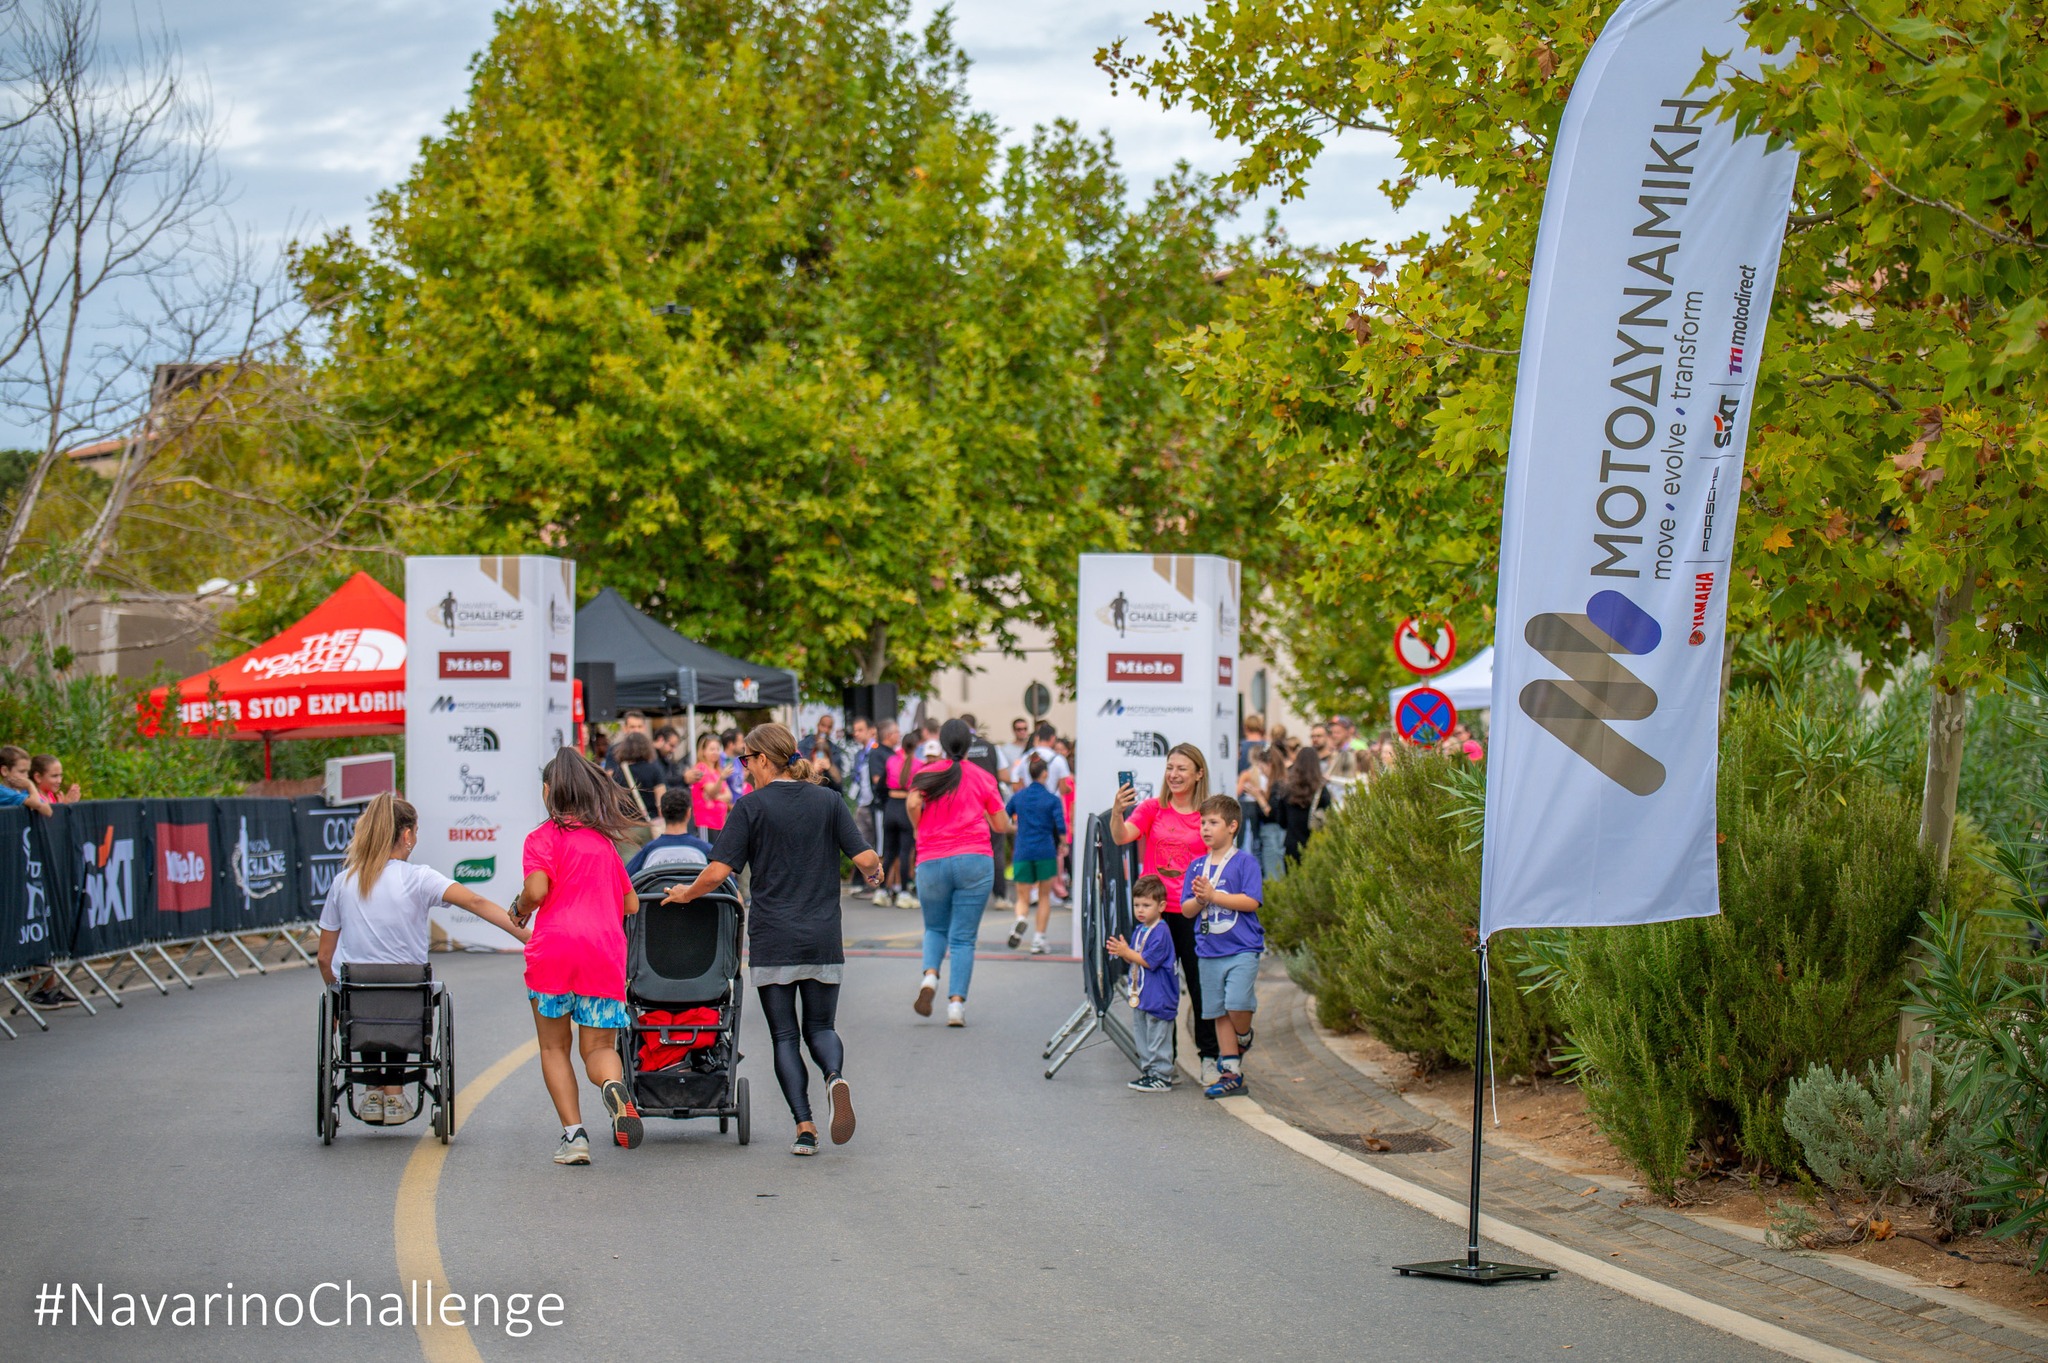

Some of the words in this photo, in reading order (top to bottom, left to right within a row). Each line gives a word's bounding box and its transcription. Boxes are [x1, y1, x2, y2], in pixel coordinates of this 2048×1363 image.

[1731, 264, 1757, 346] motodirect
[1590, 99, 1710, 578] ΜΟΤΟΔΥΝΑΜΙΚΗ
[1670, 291, 1704, 400] transform
[1660, 422, 1687, 496] evolve
[1702, 465, 1720, 552] PORSCHE
[1655, 518, 1676, 580] move
[1691, 572, 1714, 631] YAMAHA
[457, 609, 524, 621] CHALLENGE
[1128, 611, 1198, 622] CHALLENGE
[301, 629, 361, 650] THE
[241, 645, 354, 674] NORTH
[446, 658, 504, 672] Miele
[264, 659, 344, 680] FACE
[1115, 660, 1175, 675] Miele
[248, 695, 302, 719] STOP
[307, 690, 406, 716] EXPLORIN
[464, 727, 483, 735] THE
[1132, 731, 1151, 740] THE
[449, 735, 484, 744] NORTH
[1116, 740, 1152, 748] NORTH
[457, 743, 483, 752] FACE
[1126, 749, 1151, 757] FACE
[448, 828, 497, 842] ΒΙΚΟΣ
[455, 863, 493, 877] Knorr
